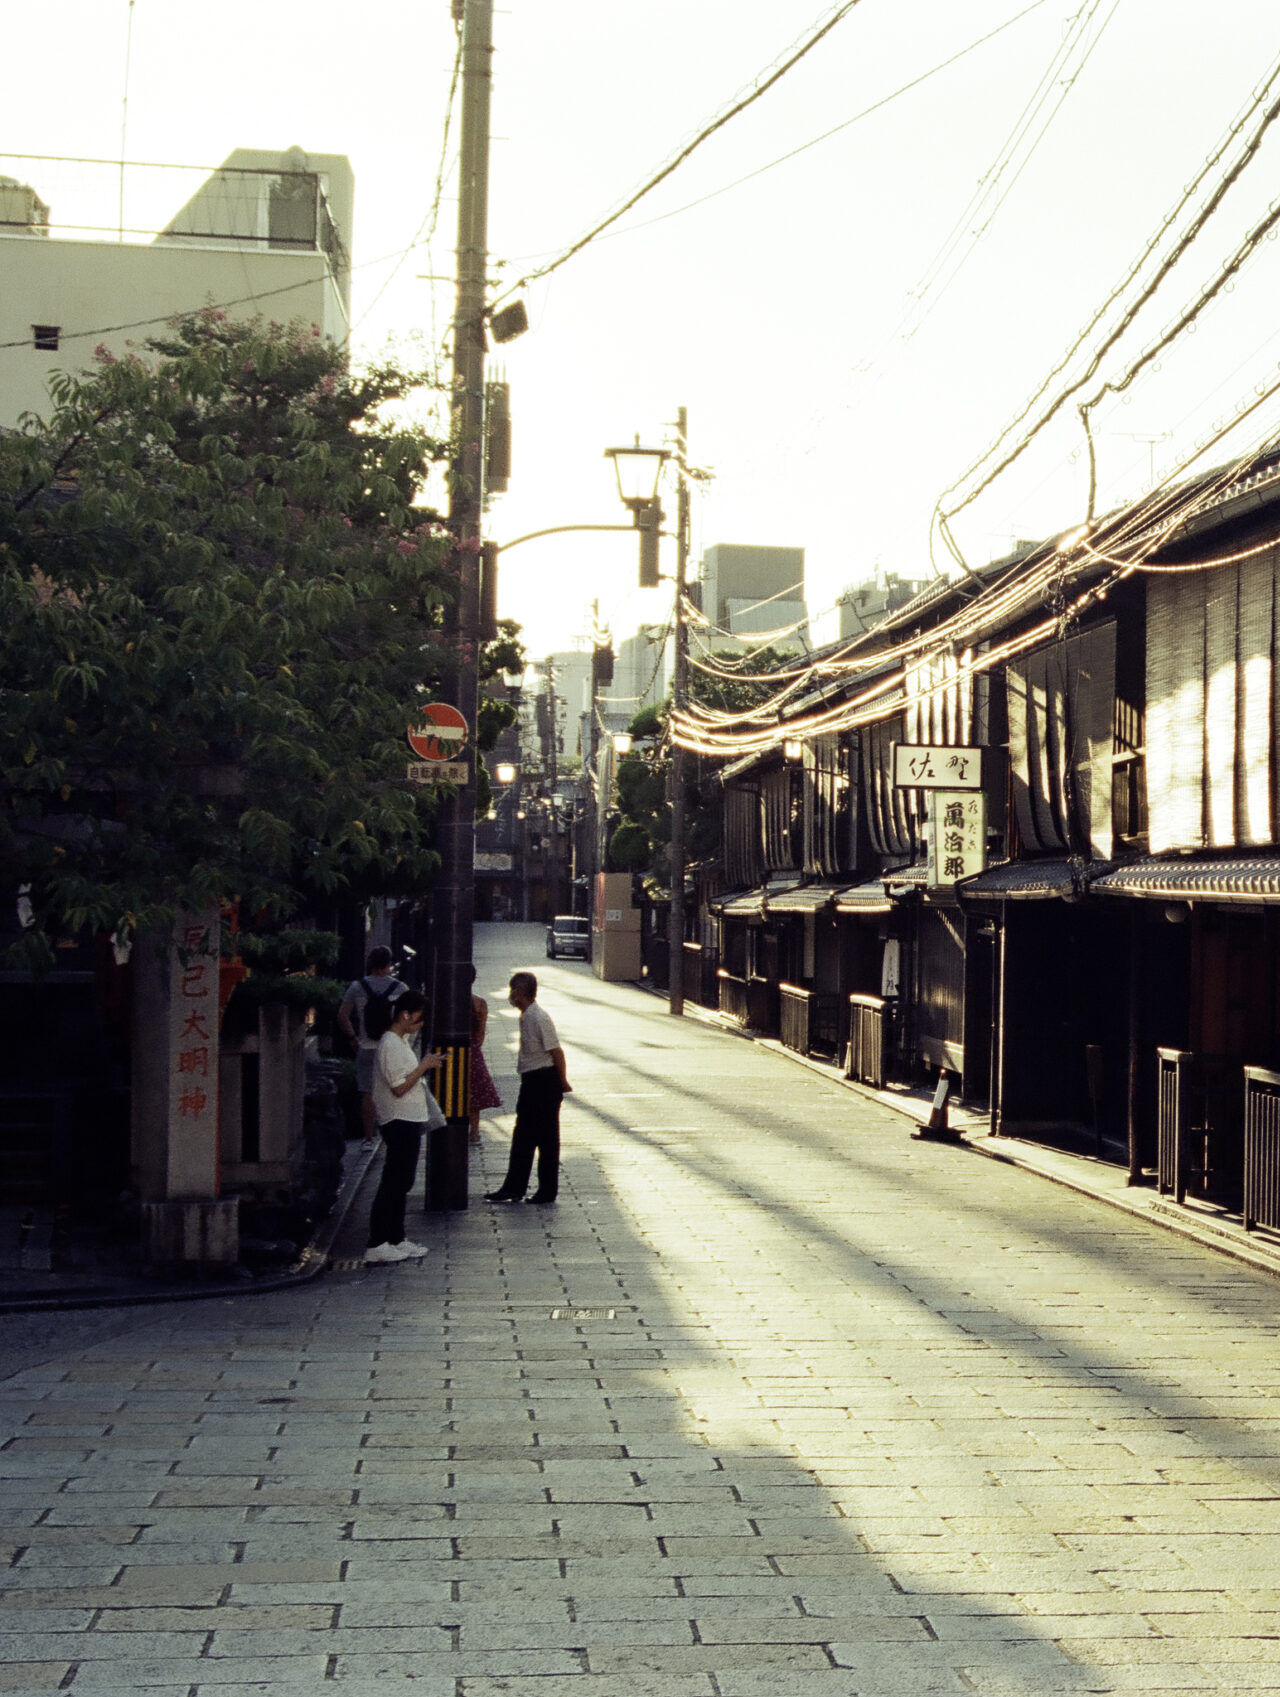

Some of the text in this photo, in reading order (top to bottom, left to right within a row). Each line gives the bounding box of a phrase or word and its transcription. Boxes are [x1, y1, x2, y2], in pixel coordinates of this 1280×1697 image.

[908, 751, 969, 781] 佐野
[943, 801, 965, 879] 萬治郎
